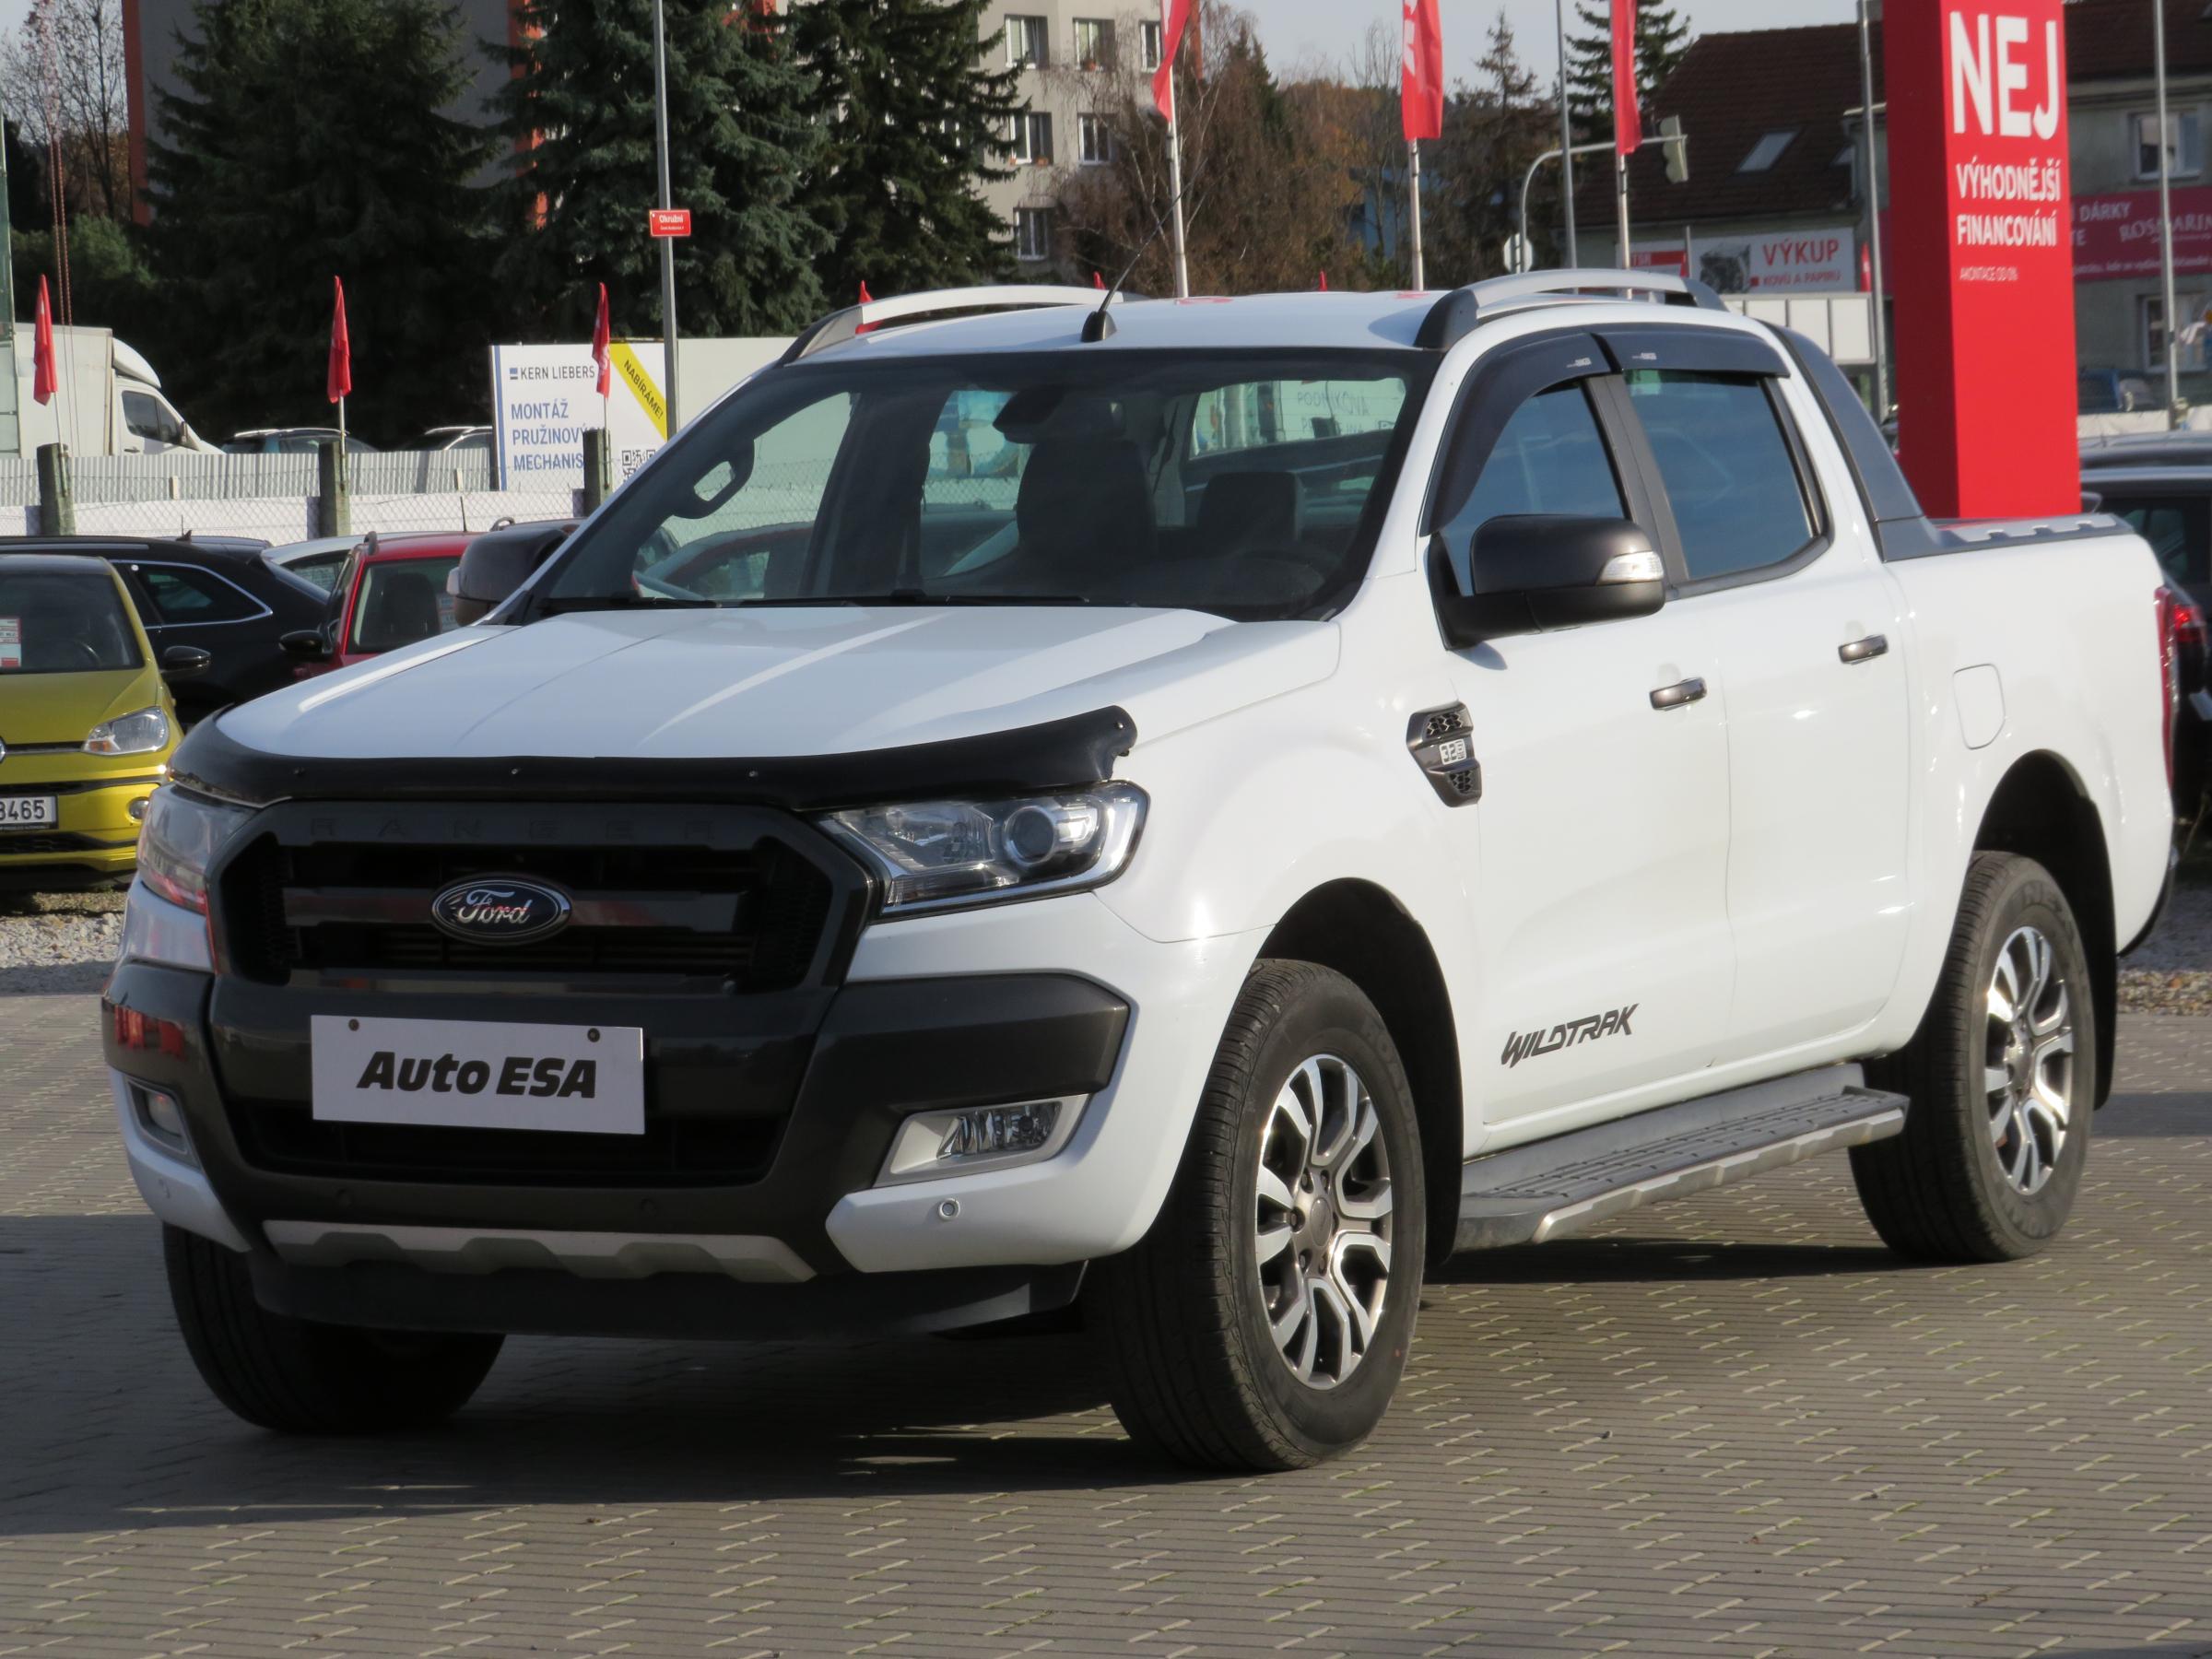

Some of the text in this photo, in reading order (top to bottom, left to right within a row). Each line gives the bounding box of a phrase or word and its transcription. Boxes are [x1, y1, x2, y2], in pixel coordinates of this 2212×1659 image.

[1949, 11, 2060, 140] NEJ
[1956, 155, 2061, 202] VÝHODNĚJŠÍ
[1956, 209, 2058, 247] FINANCOVÁNÍ
[1763, 238, 1840, 266] VÝKUP
[521, 366, 595, 380] KERN LIEBERS
[624, 359, 664, 419] NABÍRÁME!
[511, 398, 569, 419] MONTÁŽ
[513, 453, 584, 471] MECHANIS
[457, 888, 534, 924] Ford
[1500, 1003, 1640, 1068] WILDTRAK
[357, 1050, 596, 1099] Auto ESA
